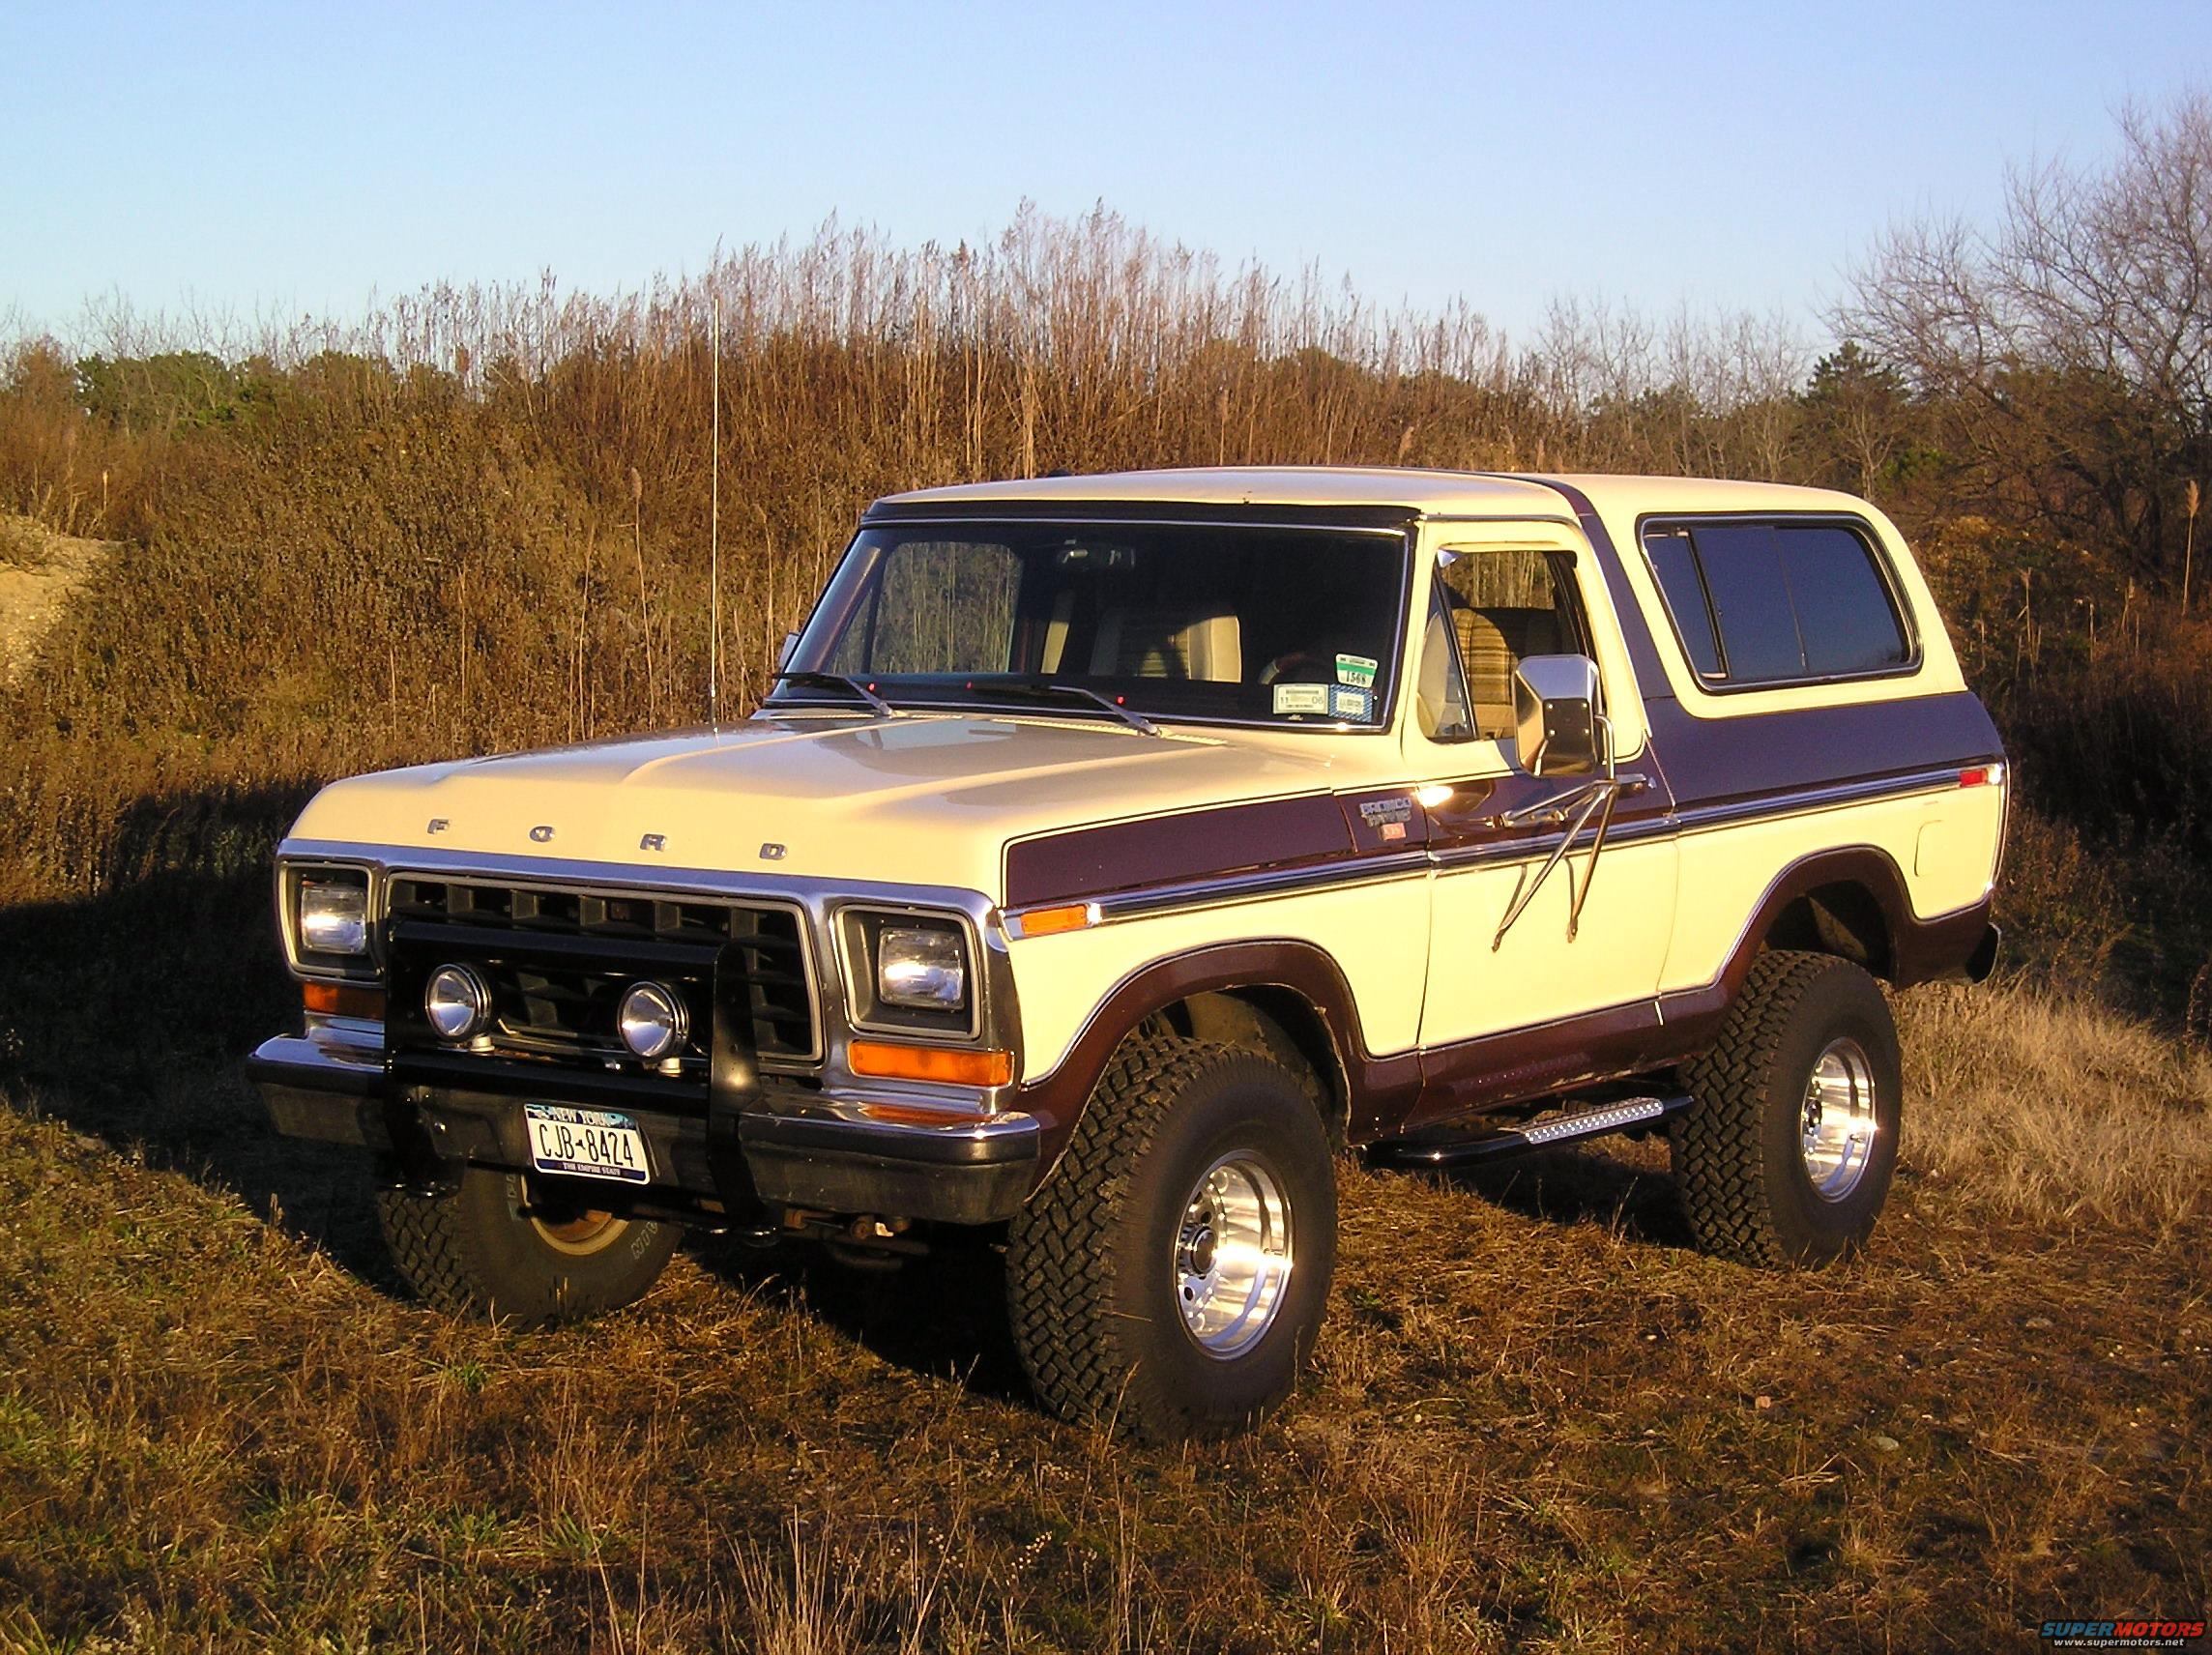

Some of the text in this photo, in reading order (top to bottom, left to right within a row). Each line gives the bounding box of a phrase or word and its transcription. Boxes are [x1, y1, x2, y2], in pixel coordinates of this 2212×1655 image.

[426, 818, 788, 861] FORD
[553, 1107, 610, 1127] NEW YORK
